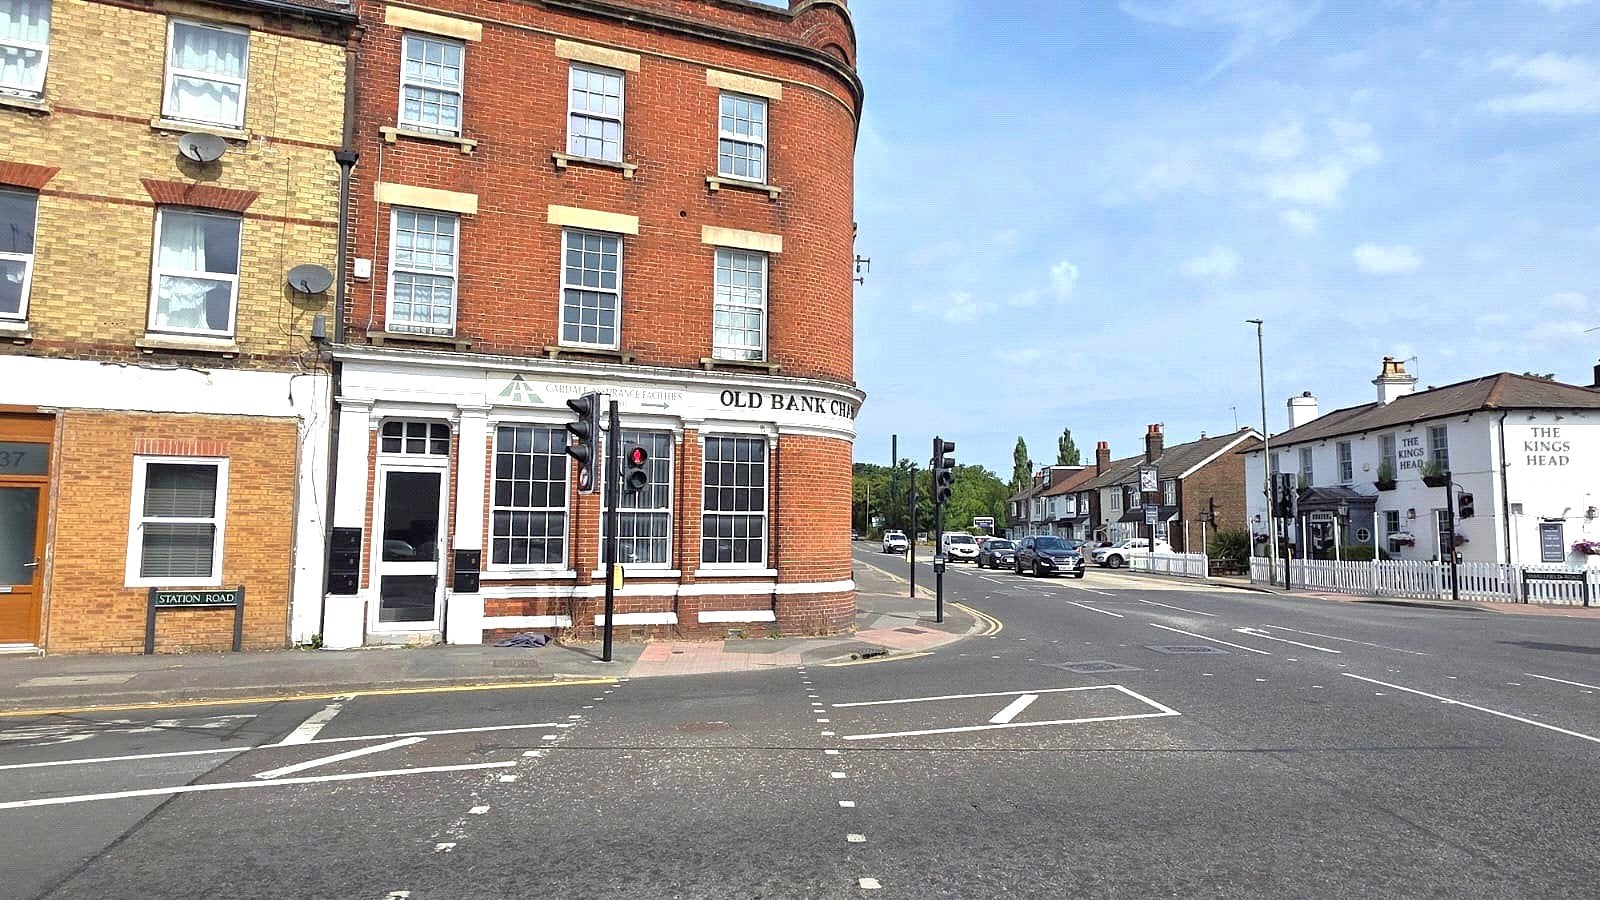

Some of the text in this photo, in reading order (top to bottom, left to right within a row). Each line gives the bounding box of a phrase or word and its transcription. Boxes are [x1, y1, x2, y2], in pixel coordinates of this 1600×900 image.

[720, 390, 763, 409] OLD
[770, 393, 826, 414] BANK
[1530, 427, 1561, 438] THE
[1402, 436, 1419, 447] THE
[1524, 441, 1571, 452] KINGS
[1398, 447, 1424, 459] KINGS
[1399, 459, 1424, 470] HEAD
[1526, 455, 1570, 466] HEAD
[159, 593, 234, 603] STATION ROAD
